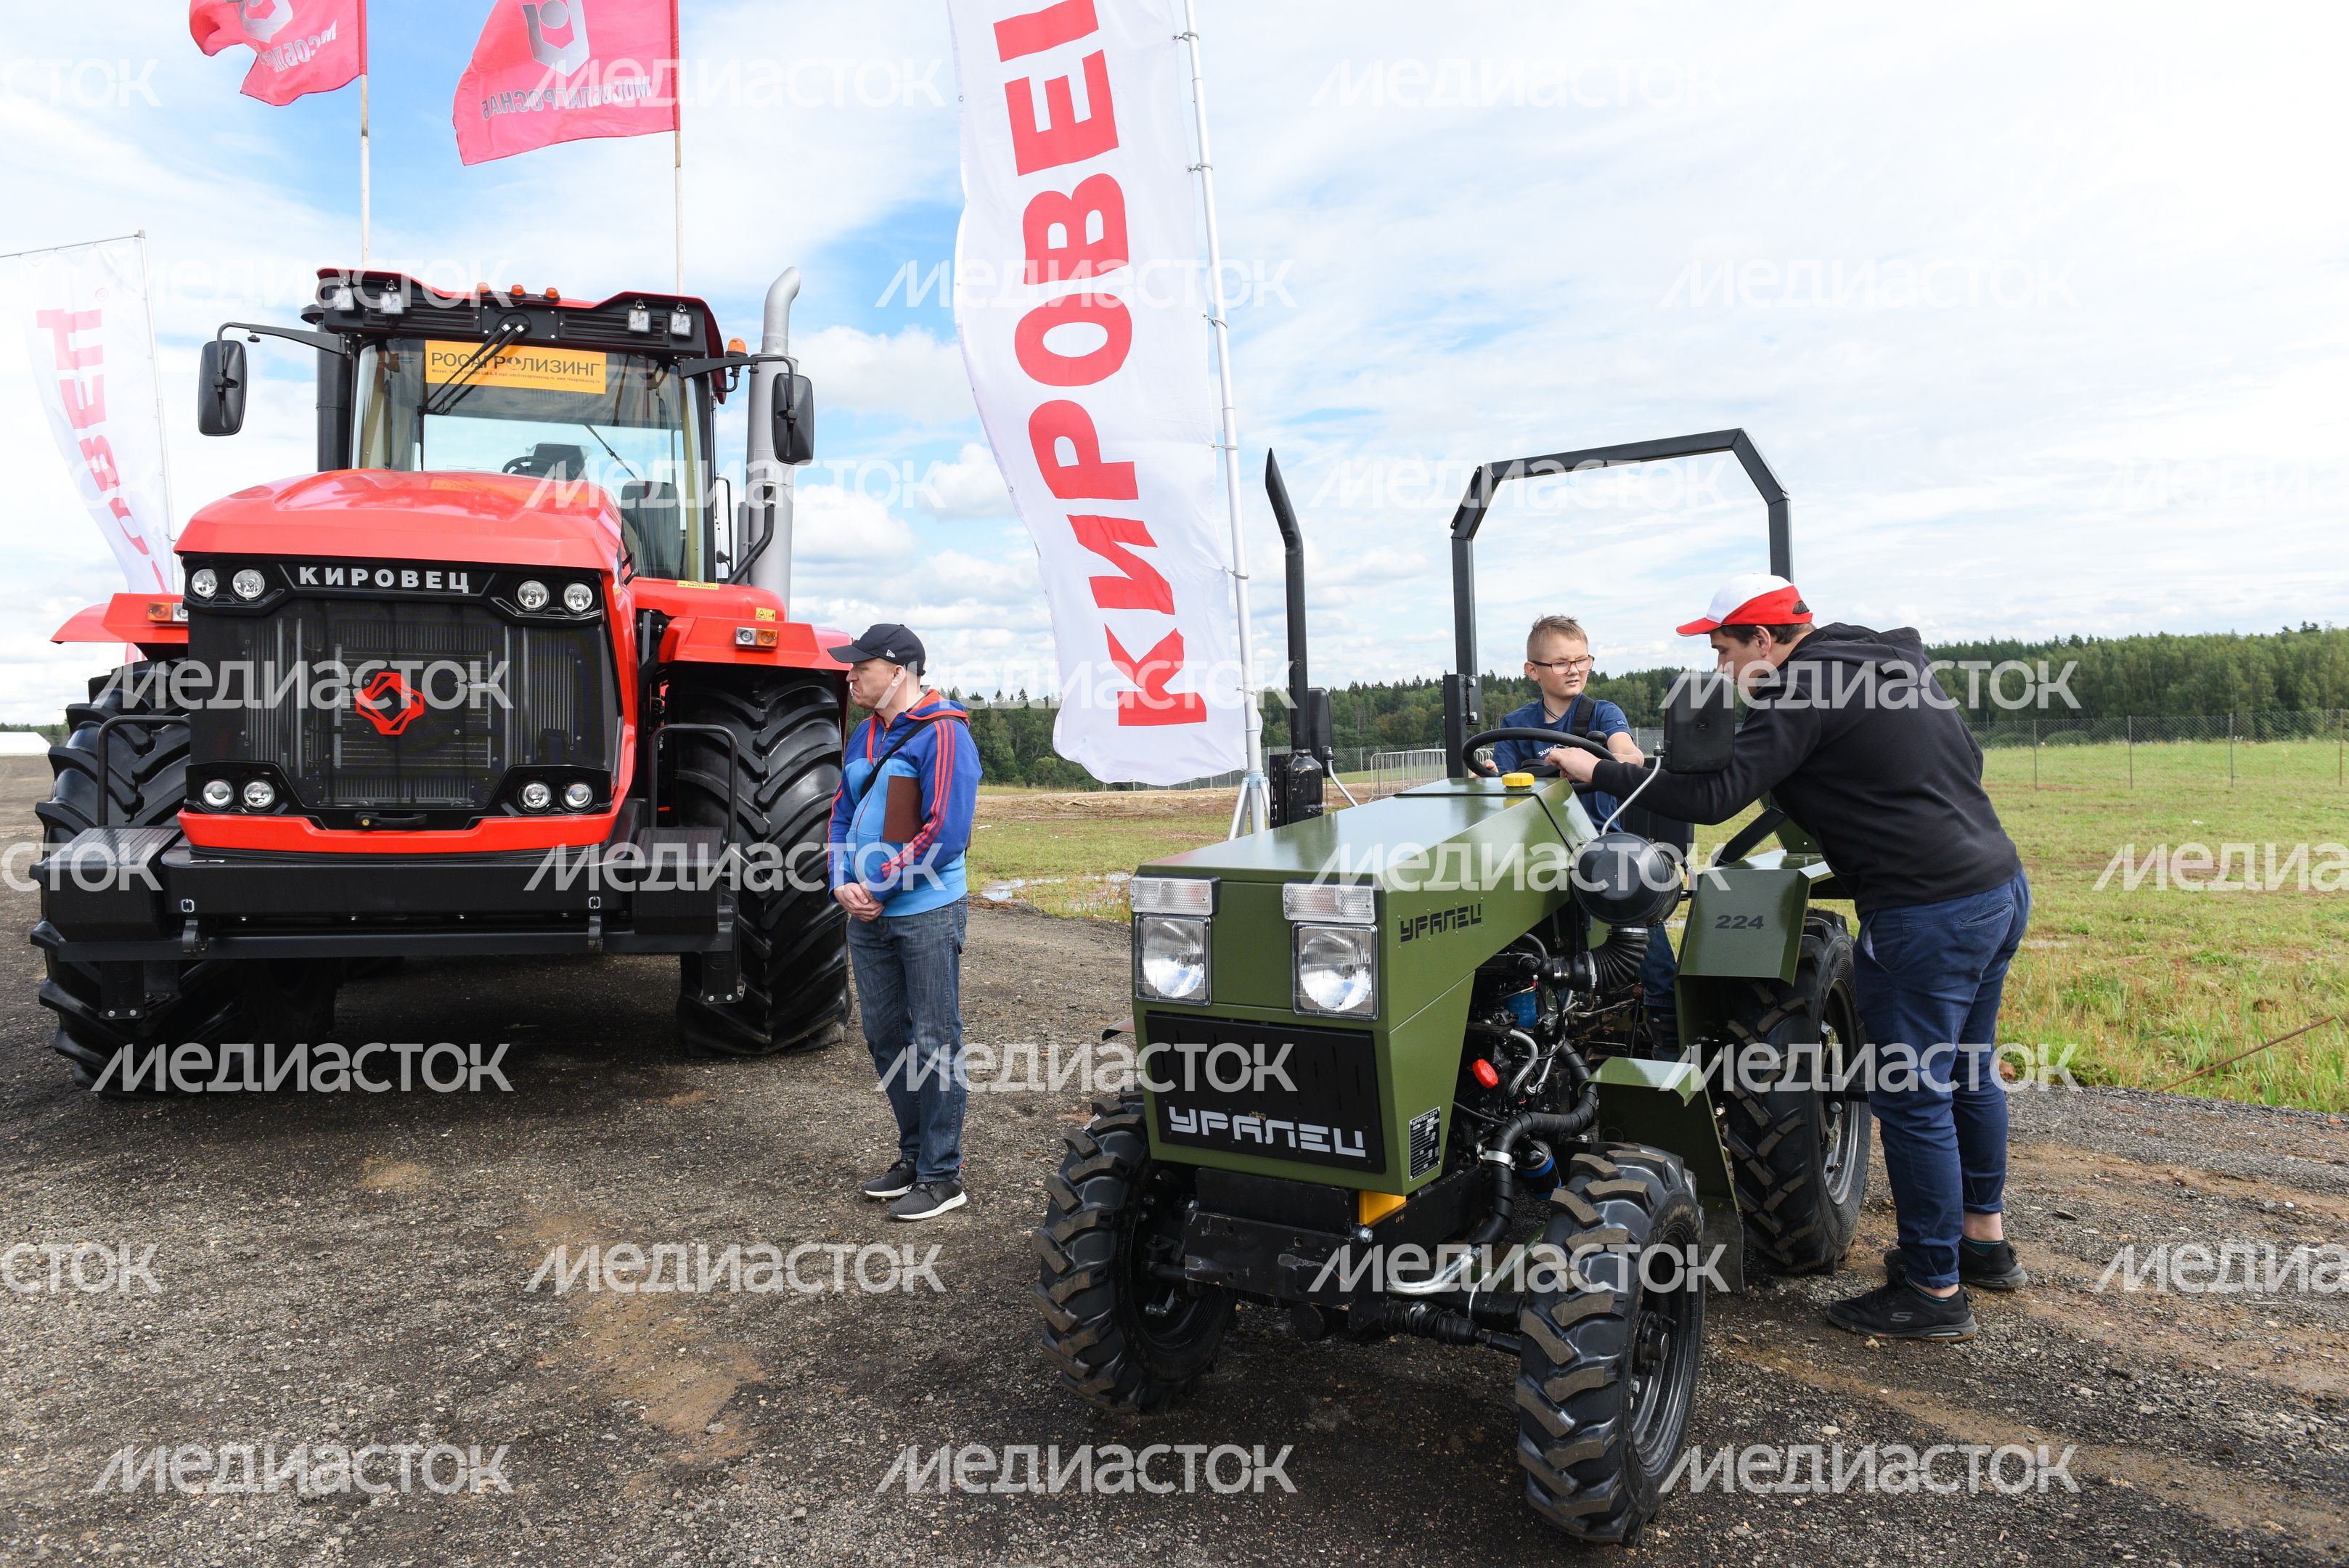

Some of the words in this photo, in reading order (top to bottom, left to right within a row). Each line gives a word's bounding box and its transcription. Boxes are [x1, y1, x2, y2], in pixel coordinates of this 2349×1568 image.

[299, 566, 469, 593] КИРОВЕЦ
[1400, 904, 1482, 942] УРАЛЕЦ
[1715, 915, 1764, 929] 224
[1169, 1106, 1365, 1157] УРАЛЕЦ
